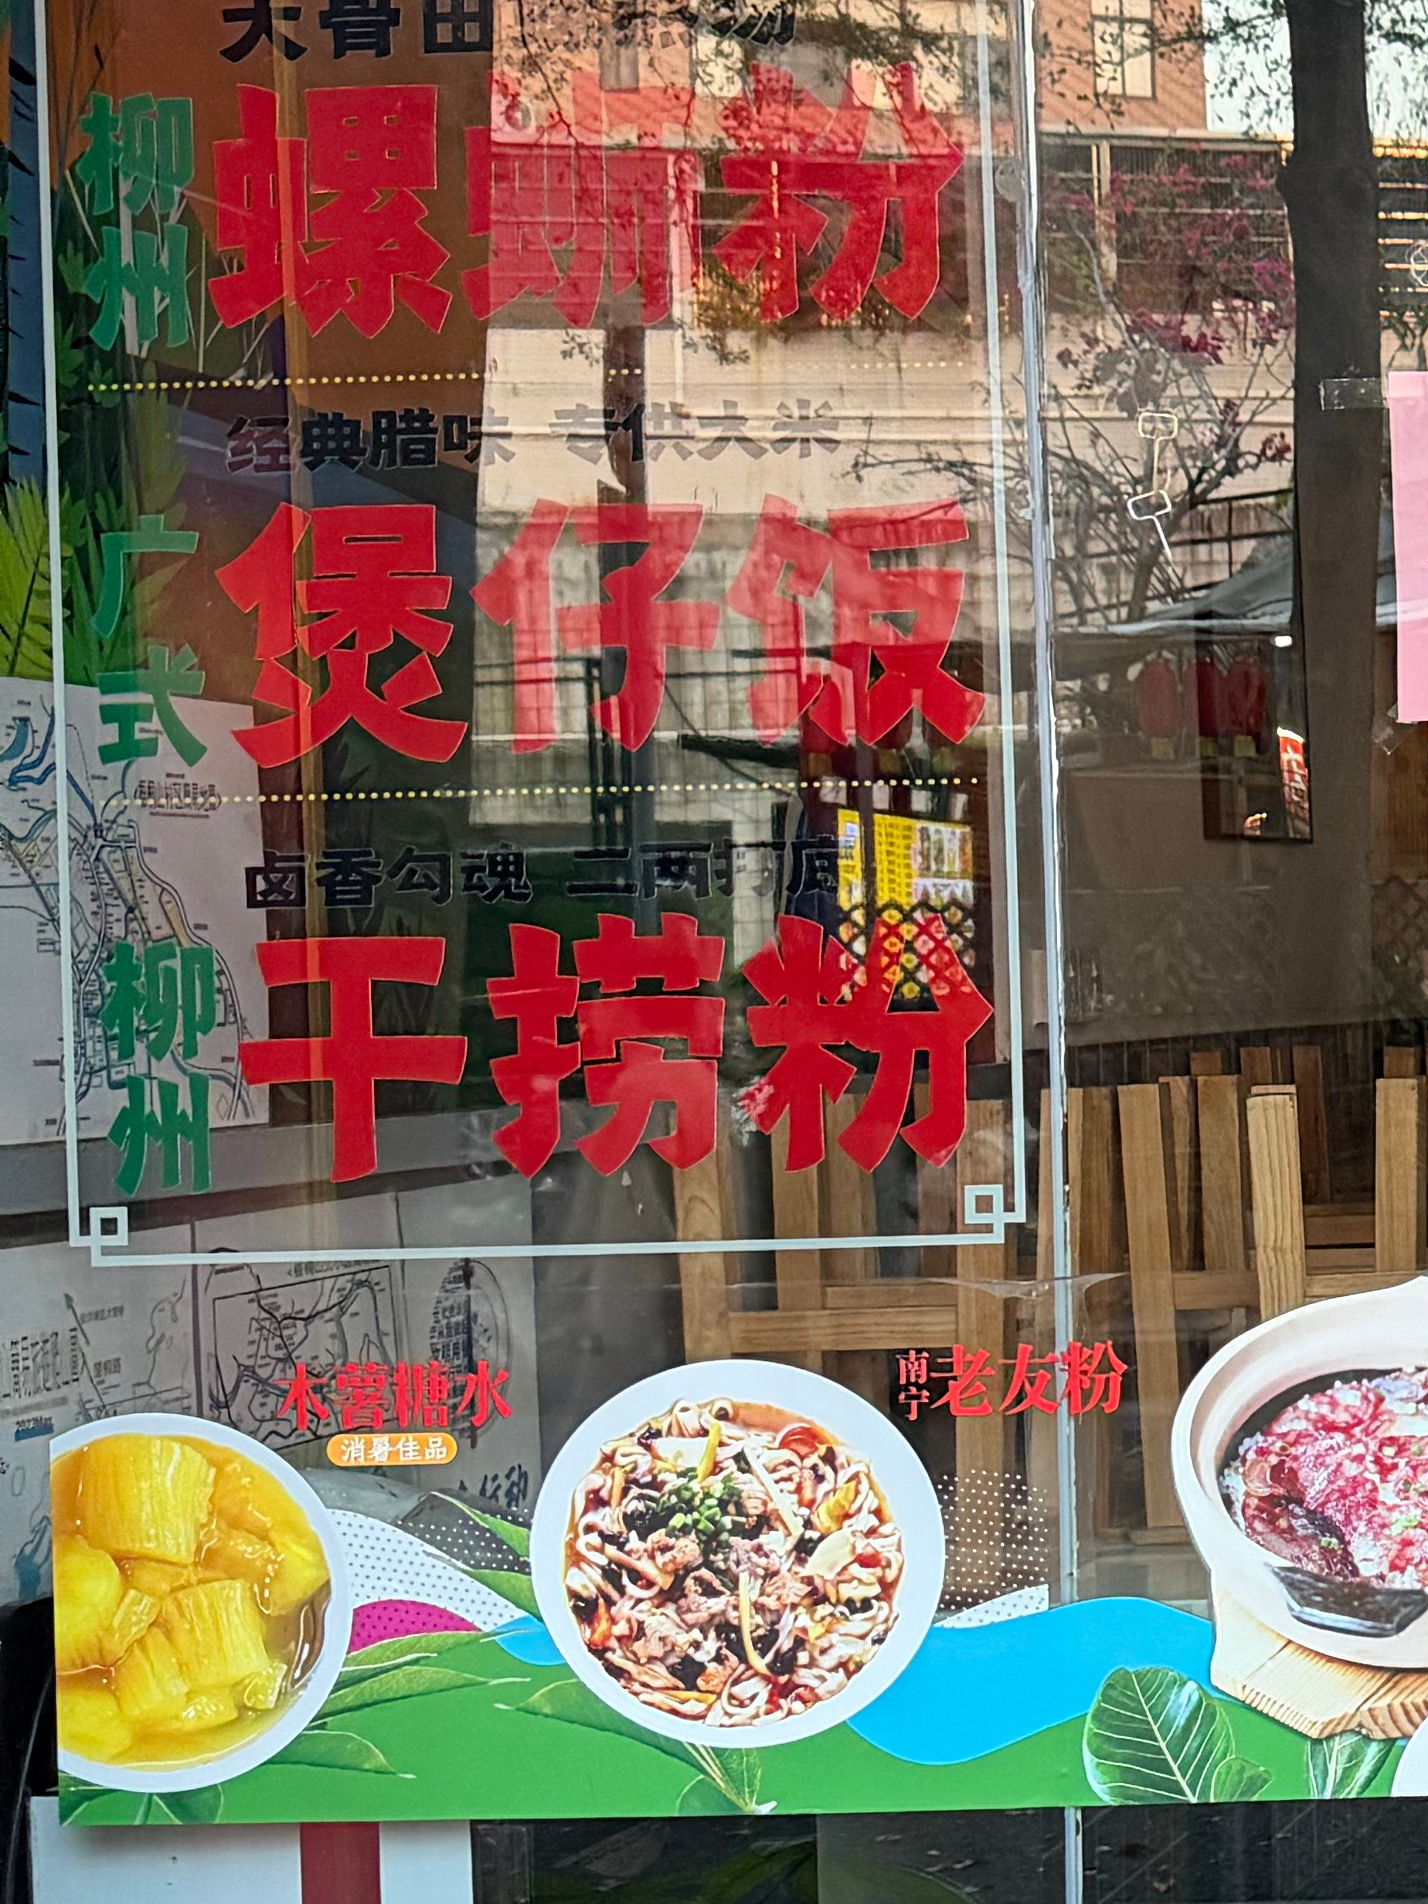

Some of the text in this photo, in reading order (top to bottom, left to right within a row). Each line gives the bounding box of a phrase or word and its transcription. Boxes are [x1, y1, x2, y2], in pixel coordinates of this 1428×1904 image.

[75, 62, 963, 352] 柳州 螺蛳粉
[225, 408, 516, 475] 经典腊味
[92, 496, 986, 769] 广式 煲仔饭
[243, 843, 533, 911] 卤香勾魂
[565, 838, 845, 902] 二两打底
[101, 913, 996, 1199] 柳州 干捞粉
[271, 1358, 513, 1435] 木薯糖水
[896, 1340, 1127, 1423] 南宁 老友粉
[340, 1436, 448, 1466] 消暑佳品
